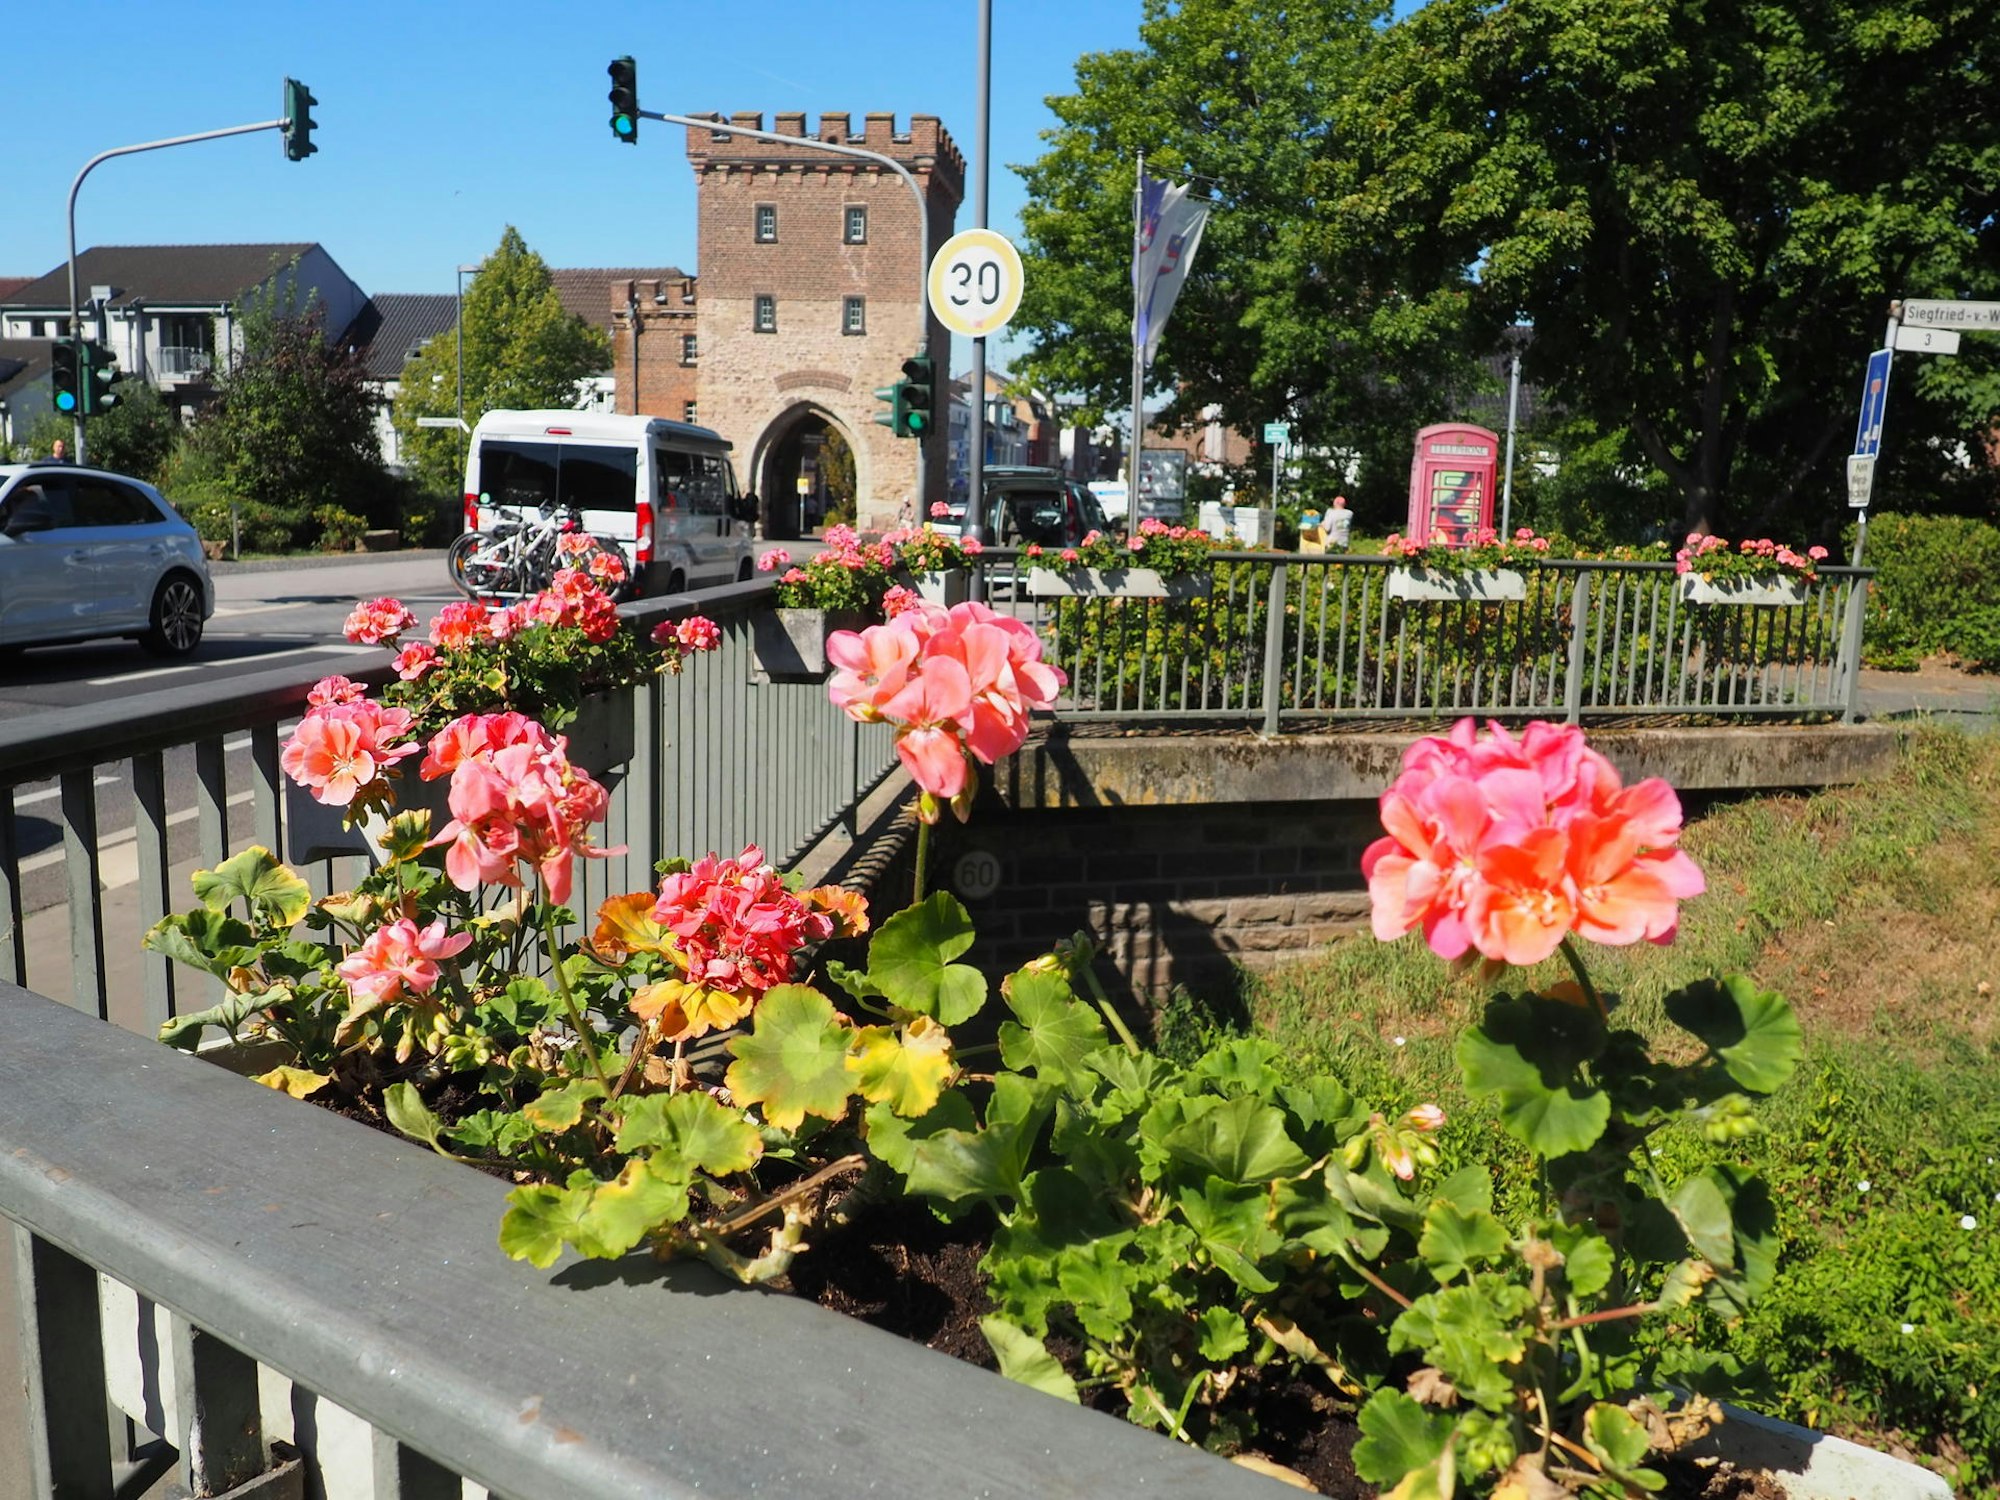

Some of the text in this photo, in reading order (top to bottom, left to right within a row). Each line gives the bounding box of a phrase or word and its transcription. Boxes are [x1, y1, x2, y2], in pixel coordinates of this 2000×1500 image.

[951, 261, 1000, 306] 30
[1924, 333, 1932, 346] 3
[1433, 444, 1485, 455] TELEPHONE
[962, 861, 993, 888] 60
